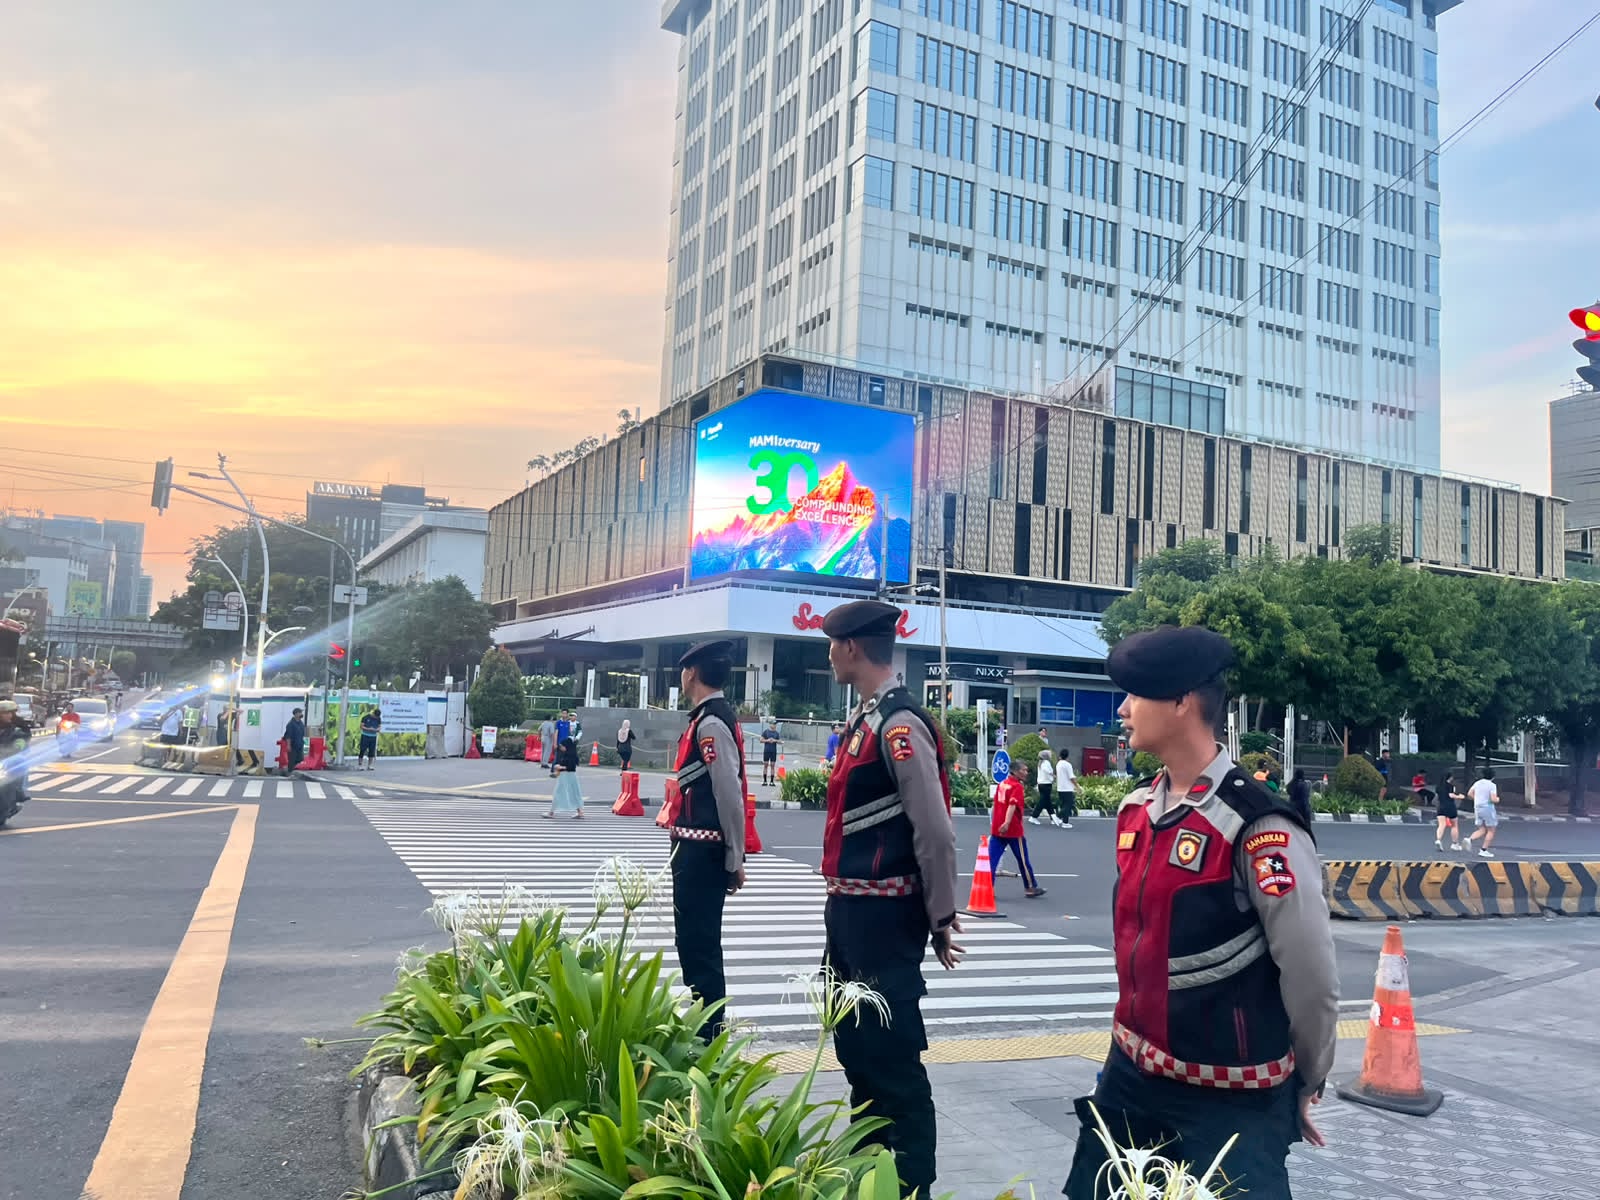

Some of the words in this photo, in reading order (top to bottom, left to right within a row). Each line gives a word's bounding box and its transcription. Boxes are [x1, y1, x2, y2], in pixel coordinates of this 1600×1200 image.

[316, 482, 368, 496] AKMANI
[746, 449, 820, 515] 30
[795, 497, 872, 516] COMPOUNDING
[795, 509, 861, 527] EXCELLENCE
[975, 667, 1004, 678] NIXX
[1246, 833, 1286, 850] BAHARKAM
